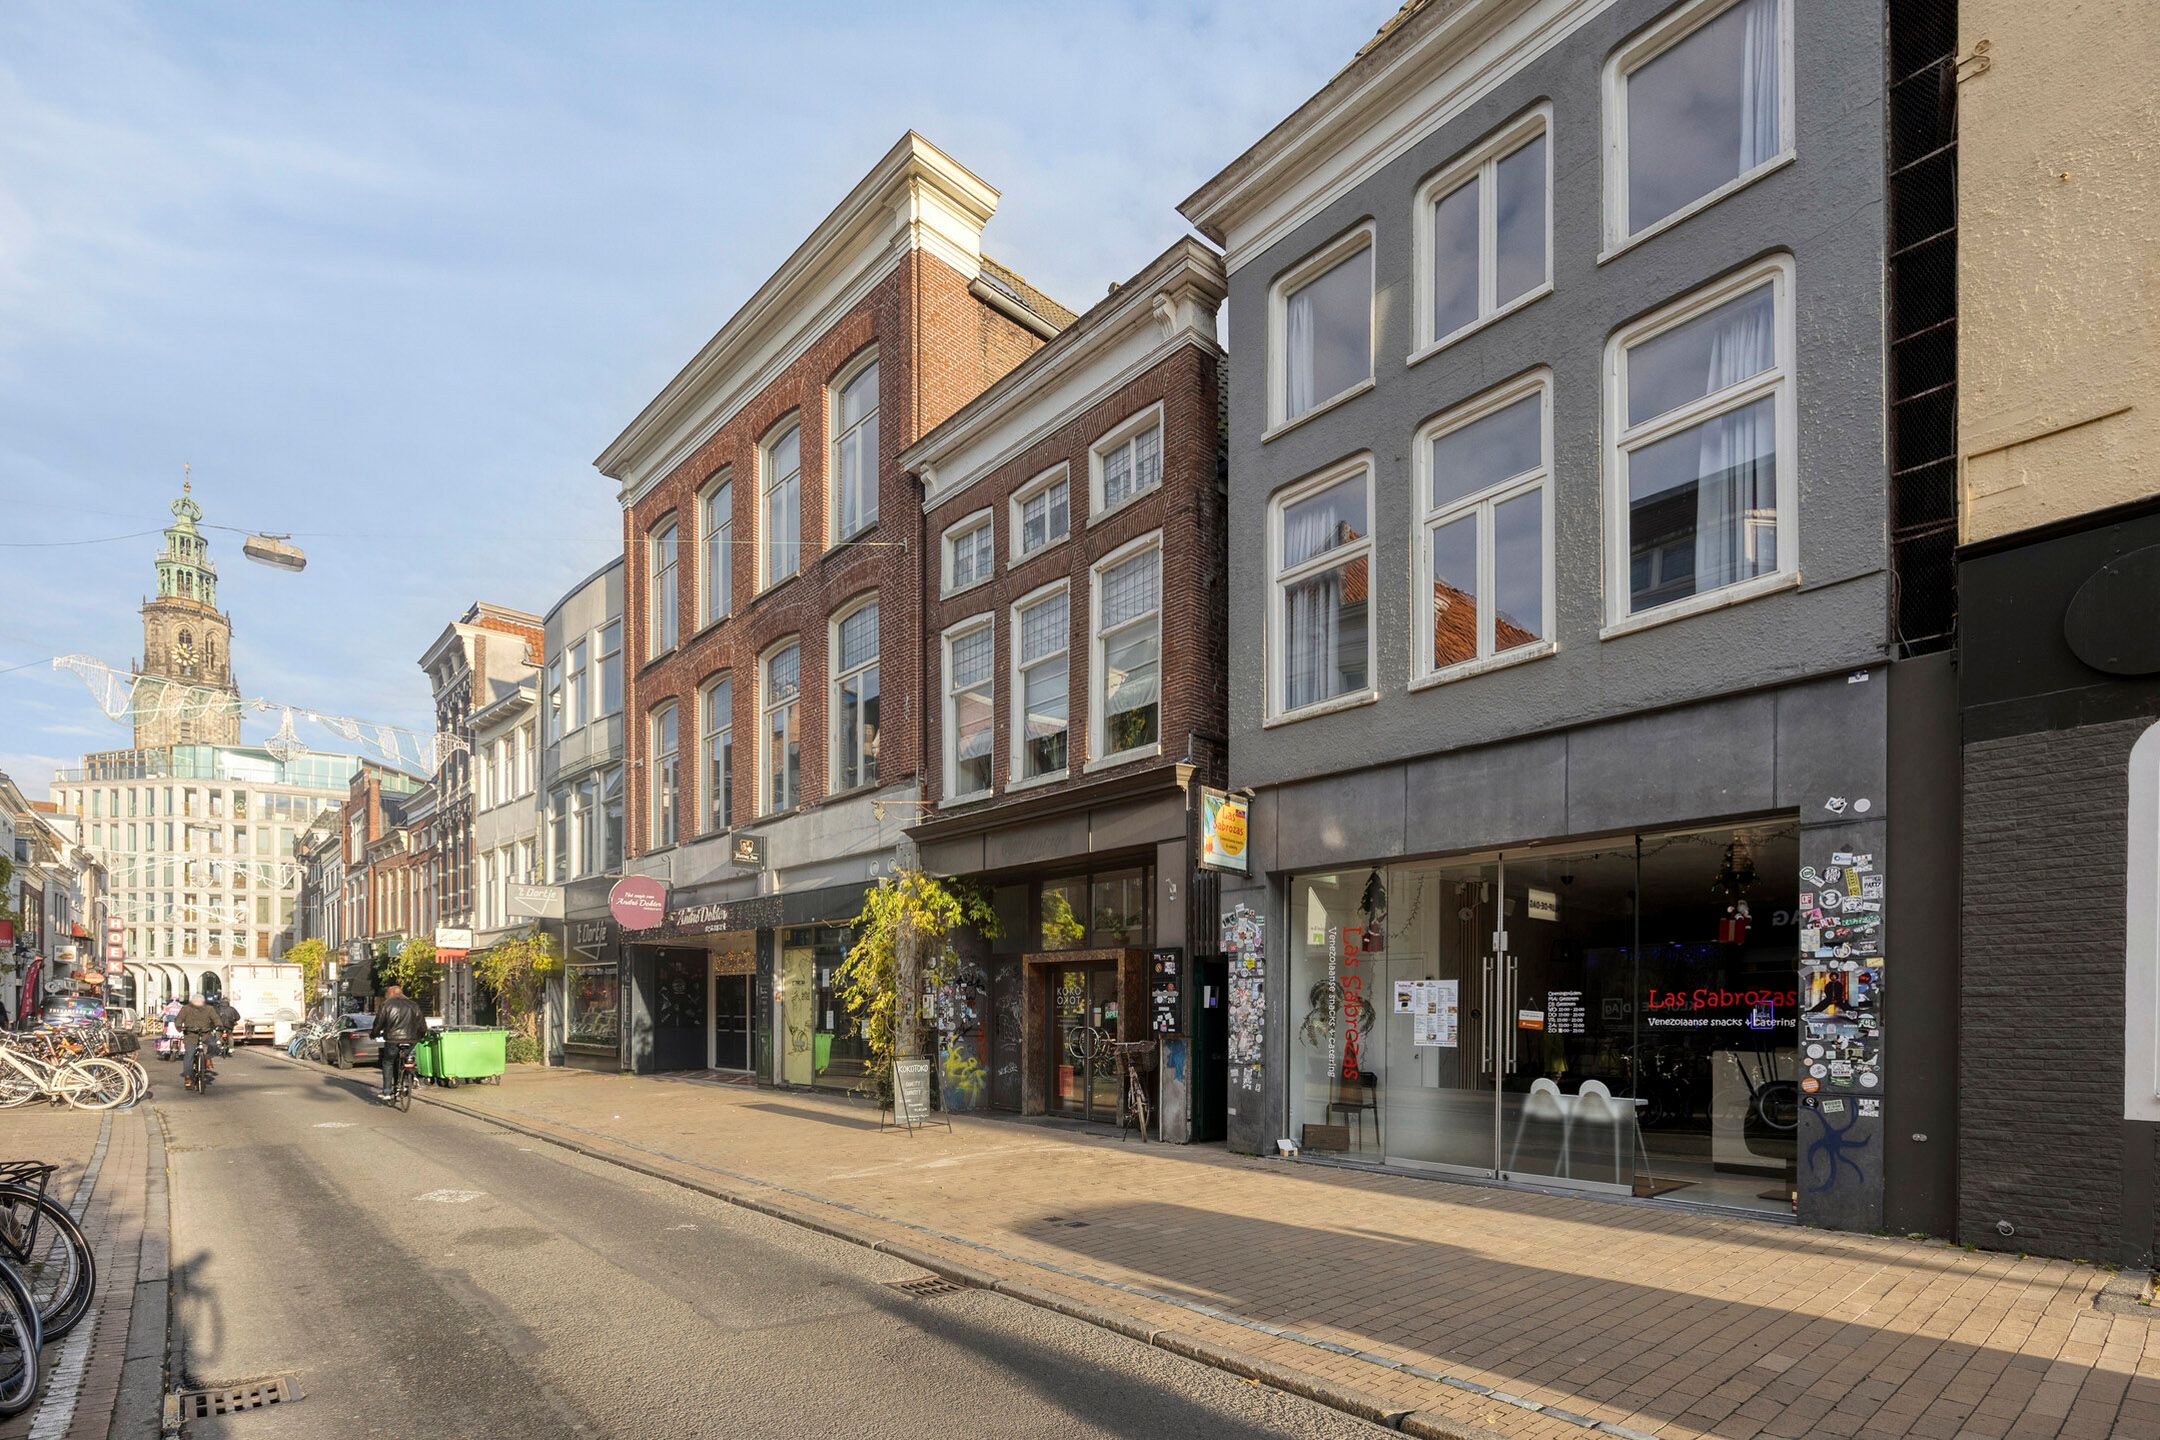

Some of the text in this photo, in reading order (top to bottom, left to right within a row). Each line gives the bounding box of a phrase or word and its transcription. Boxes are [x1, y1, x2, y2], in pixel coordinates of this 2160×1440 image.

[1222, 806, 1236, 822] Las
[1213, 818, 1244, 837] Sabrozas
[615, 897, 638, 906] André
[639, 898, 662, 908] Dokter
[700, 904, 728, 923] Dokter
[110, 919, 122, 972] HOEK
[1341, 927, 1364, 969] Las
[1328, 926, 1337, 992] Venezolaanse
[1056, 986, 1082, 996] KOKO
[1648, 988, 1798, 1011] Las Sabrozas
[1328, 994, 1337, 1027] snacks
[1340, 974, 1363, 1081] Sabrozas
[1648, 1018, 1709, 1027] Venezolaanse
[1710, 1018, 1743, 1027] snacks
[897, 1064, 929, 1073] KOKOTOKO
[1327, 1038, 1337, 1079] catering
